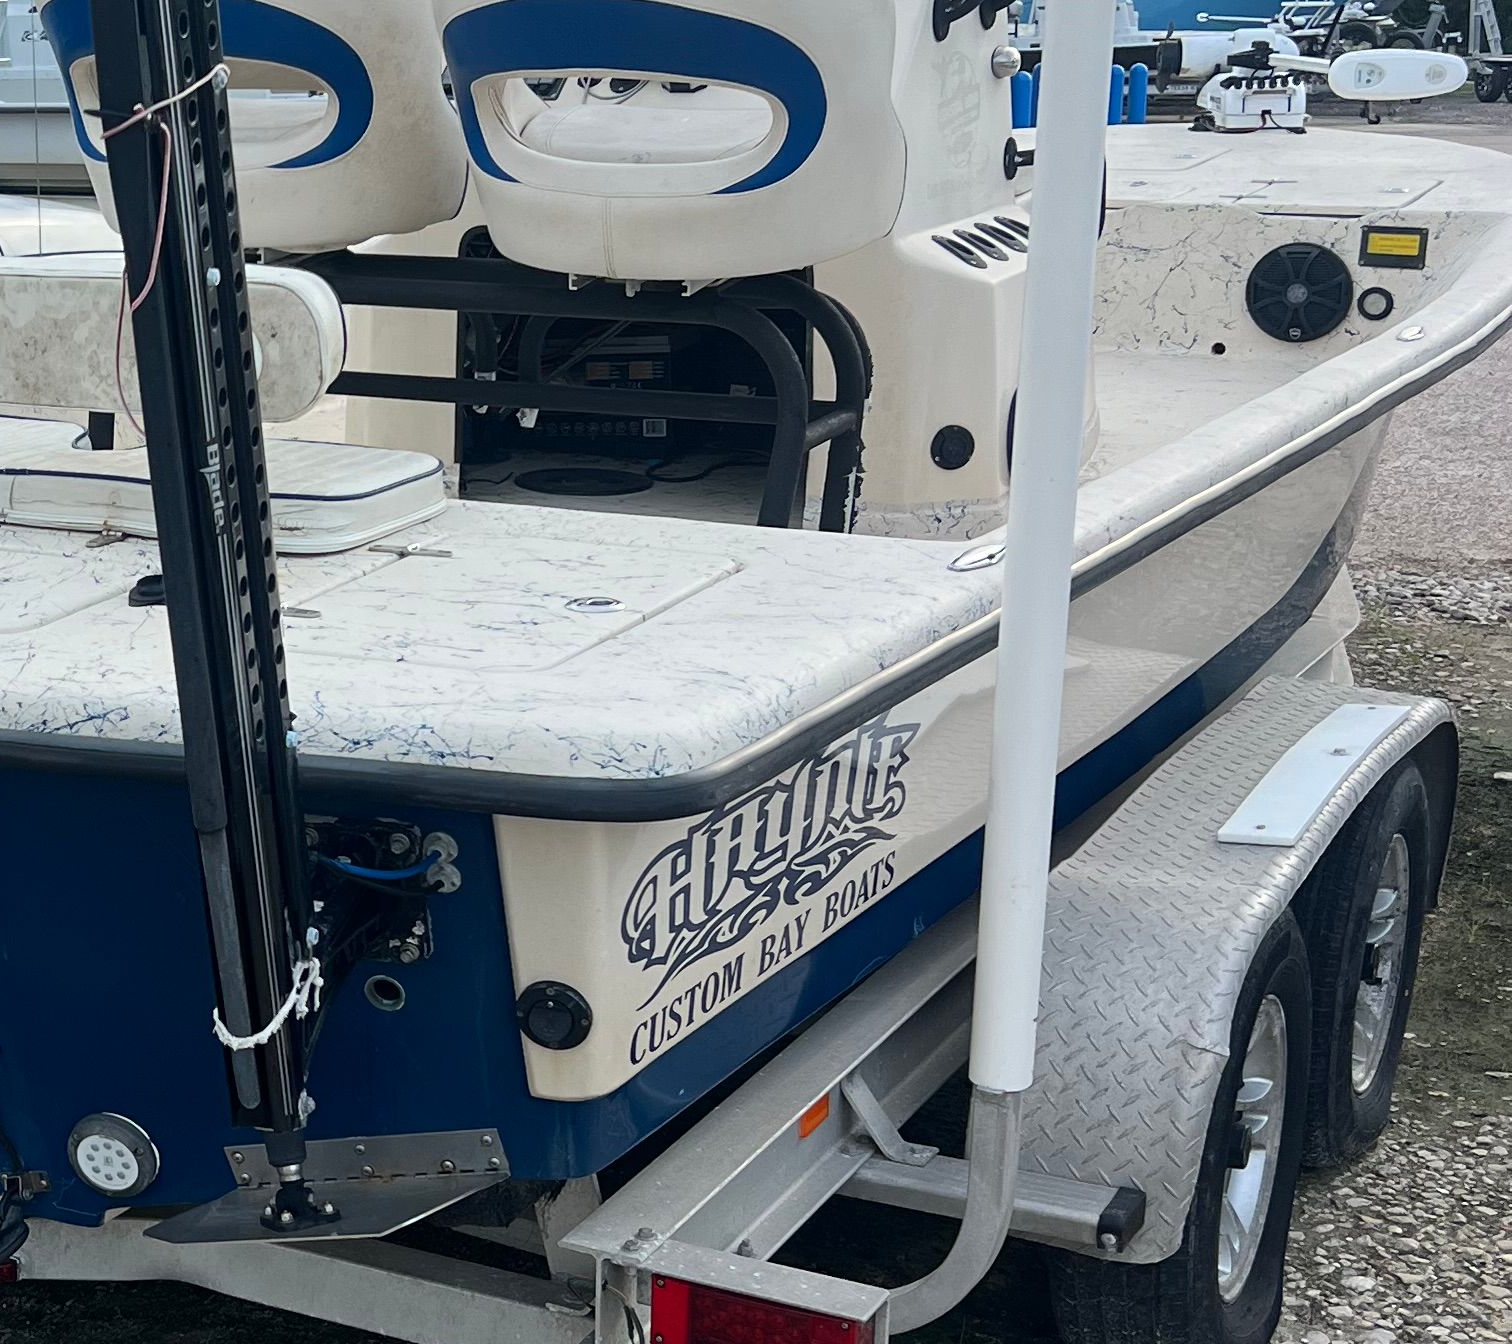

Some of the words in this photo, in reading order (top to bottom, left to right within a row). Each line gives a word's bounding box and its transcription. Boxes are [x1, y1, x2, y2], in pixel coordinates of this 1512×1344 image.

[629, 953, 745, 1067] CUSTOM
[756, 908, 812, 978] BAY
[821, 850, 897, 934] BOATS
